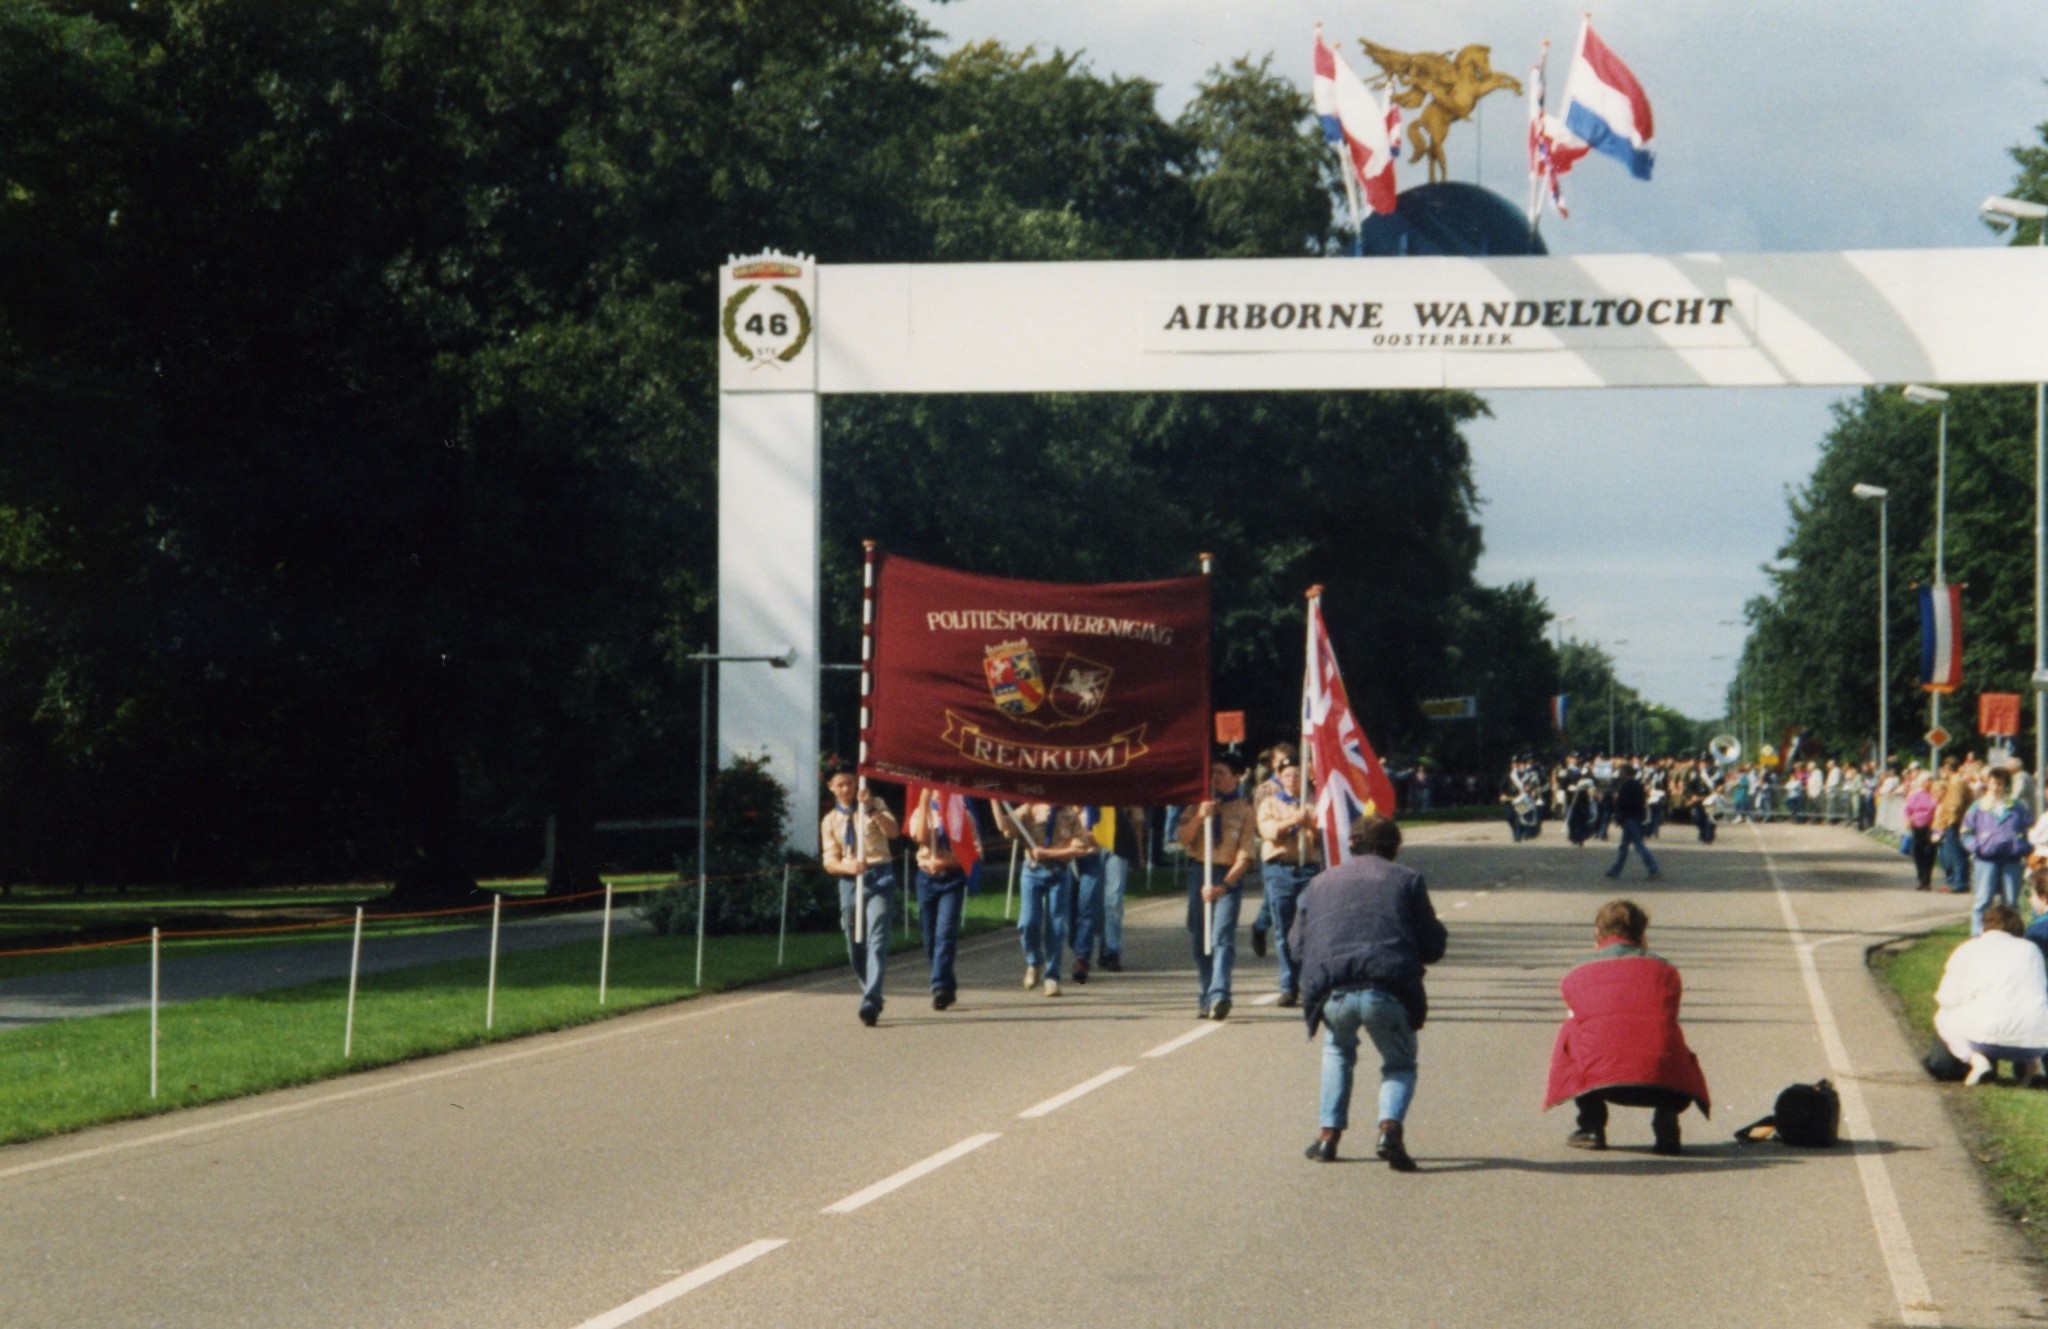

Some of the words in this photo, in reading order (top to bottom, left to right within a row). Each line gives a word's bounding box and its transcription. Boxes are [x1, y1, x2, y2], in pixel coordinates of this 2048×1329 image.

[744, 313, 788, 336] 46
[1164, 302, 1383, 330] AIRBORNE
[1413, 298, 1732, 329] WANDELTOCHT
[1372, 333, 1513, 347] OOSTERBEEK
[926, 609, 1174, 646] POLITIESPORTVERENIGING
[973, 736, 1115, 770] RENKUM
